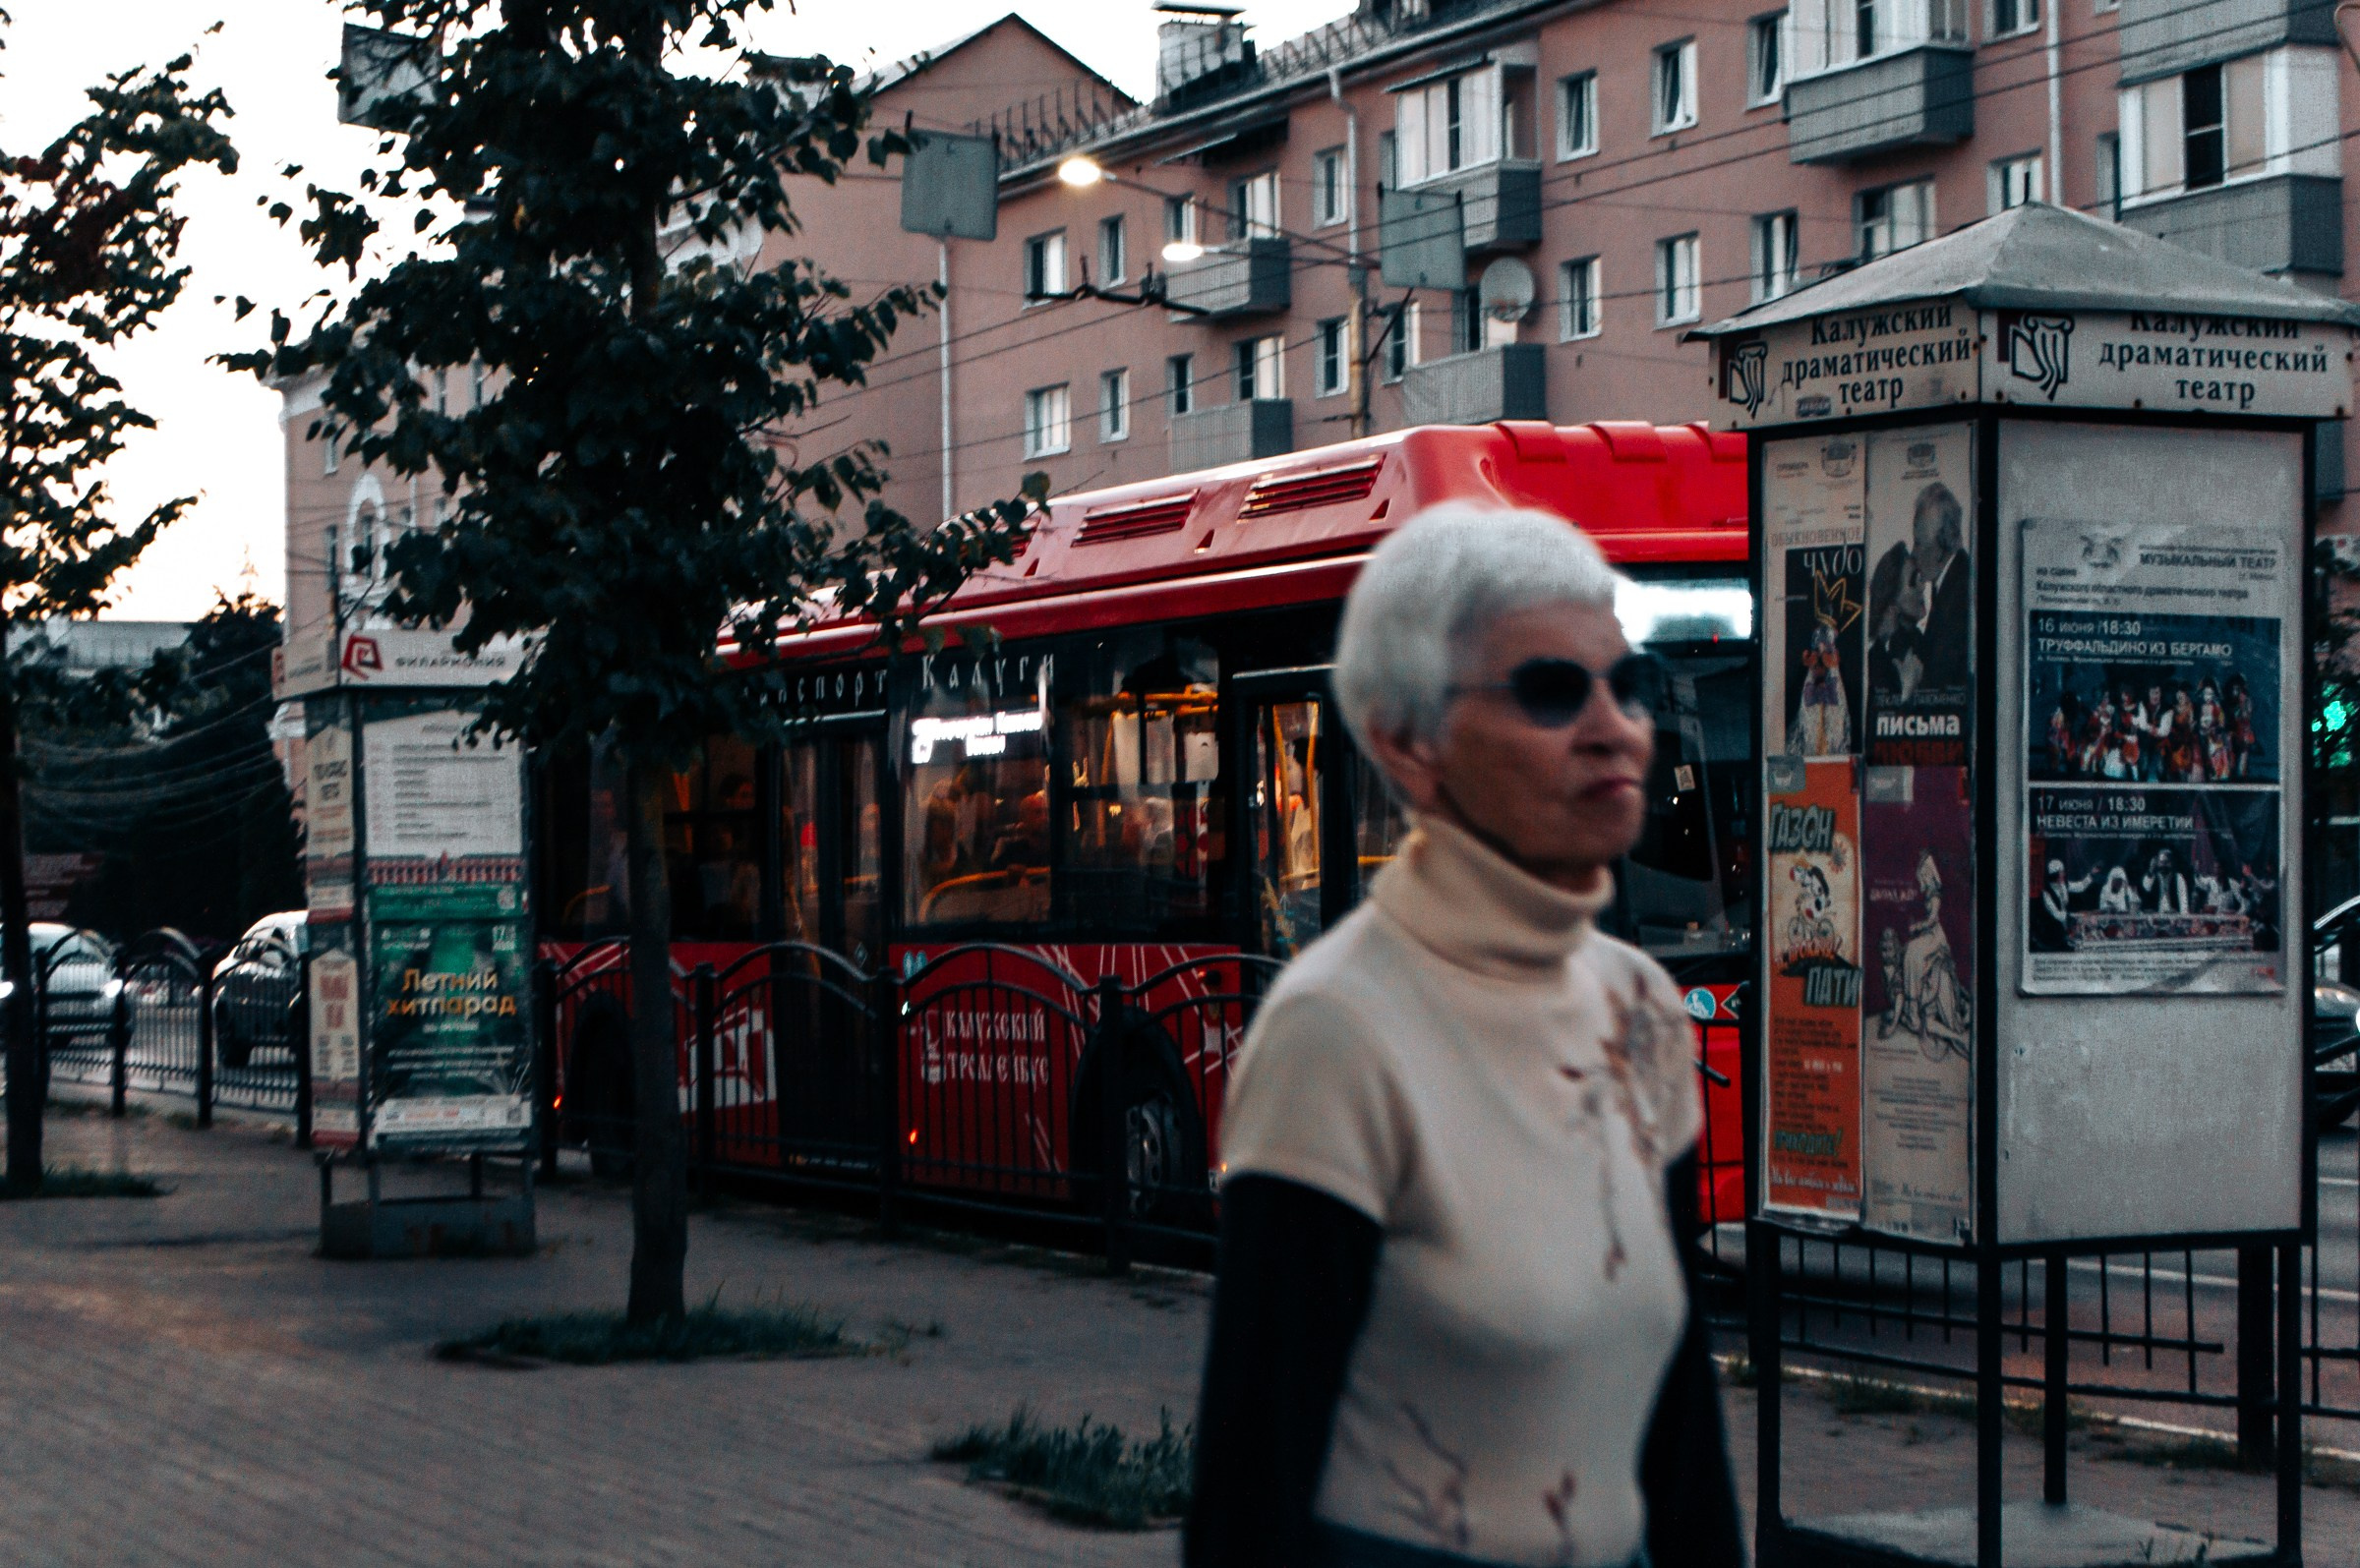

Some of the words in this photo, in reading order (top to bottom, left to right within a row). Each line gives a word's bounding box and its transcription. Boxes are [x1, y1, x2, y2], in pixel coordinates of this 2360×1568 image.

[1811, 304, 1951, 346] Калужский
[1781, 328, 1972, 389] драматический
[2099, 342, 2328, 373] драматический
[1839, 376, 1903, 409] театр
[2176, 378, 2256, 410] театр
[2140, 552, 2236, 568] МУЗЫКАЛЬНЫЙ
[2240, 555, 2276, 568] ТЕАТР
[2038, 617, 2055, 632] 16
[2058, 620, 2094, 634] июня
[2037, 638, 2146, 655] ТРУФФАЛЬДИНО
[2150, 640, 2166, 654] ИЗ
[2170, 642, 2233, 657] БЕРГАМО
[1876, 714, 1961, 735] письма
[2038, 796, 2054, 811] 17
[2059, 799, 2094, 812] июня
[2108, 796, 2146, 812] 18:30
[1770, 804, 1835, 851] ГАЗОН
[2036, 814, 2097, 830] НЕВЕСТА
[2100, 816, 2119, 830] ИЗ
[2122, 815, 2194, 830] ИМЕРЕТИИ
[401, 966, 499, 993] Летний
[1804, 965, 1860, 1007] ПАТИ
[385, 995, 517, 1020] хитпарад
